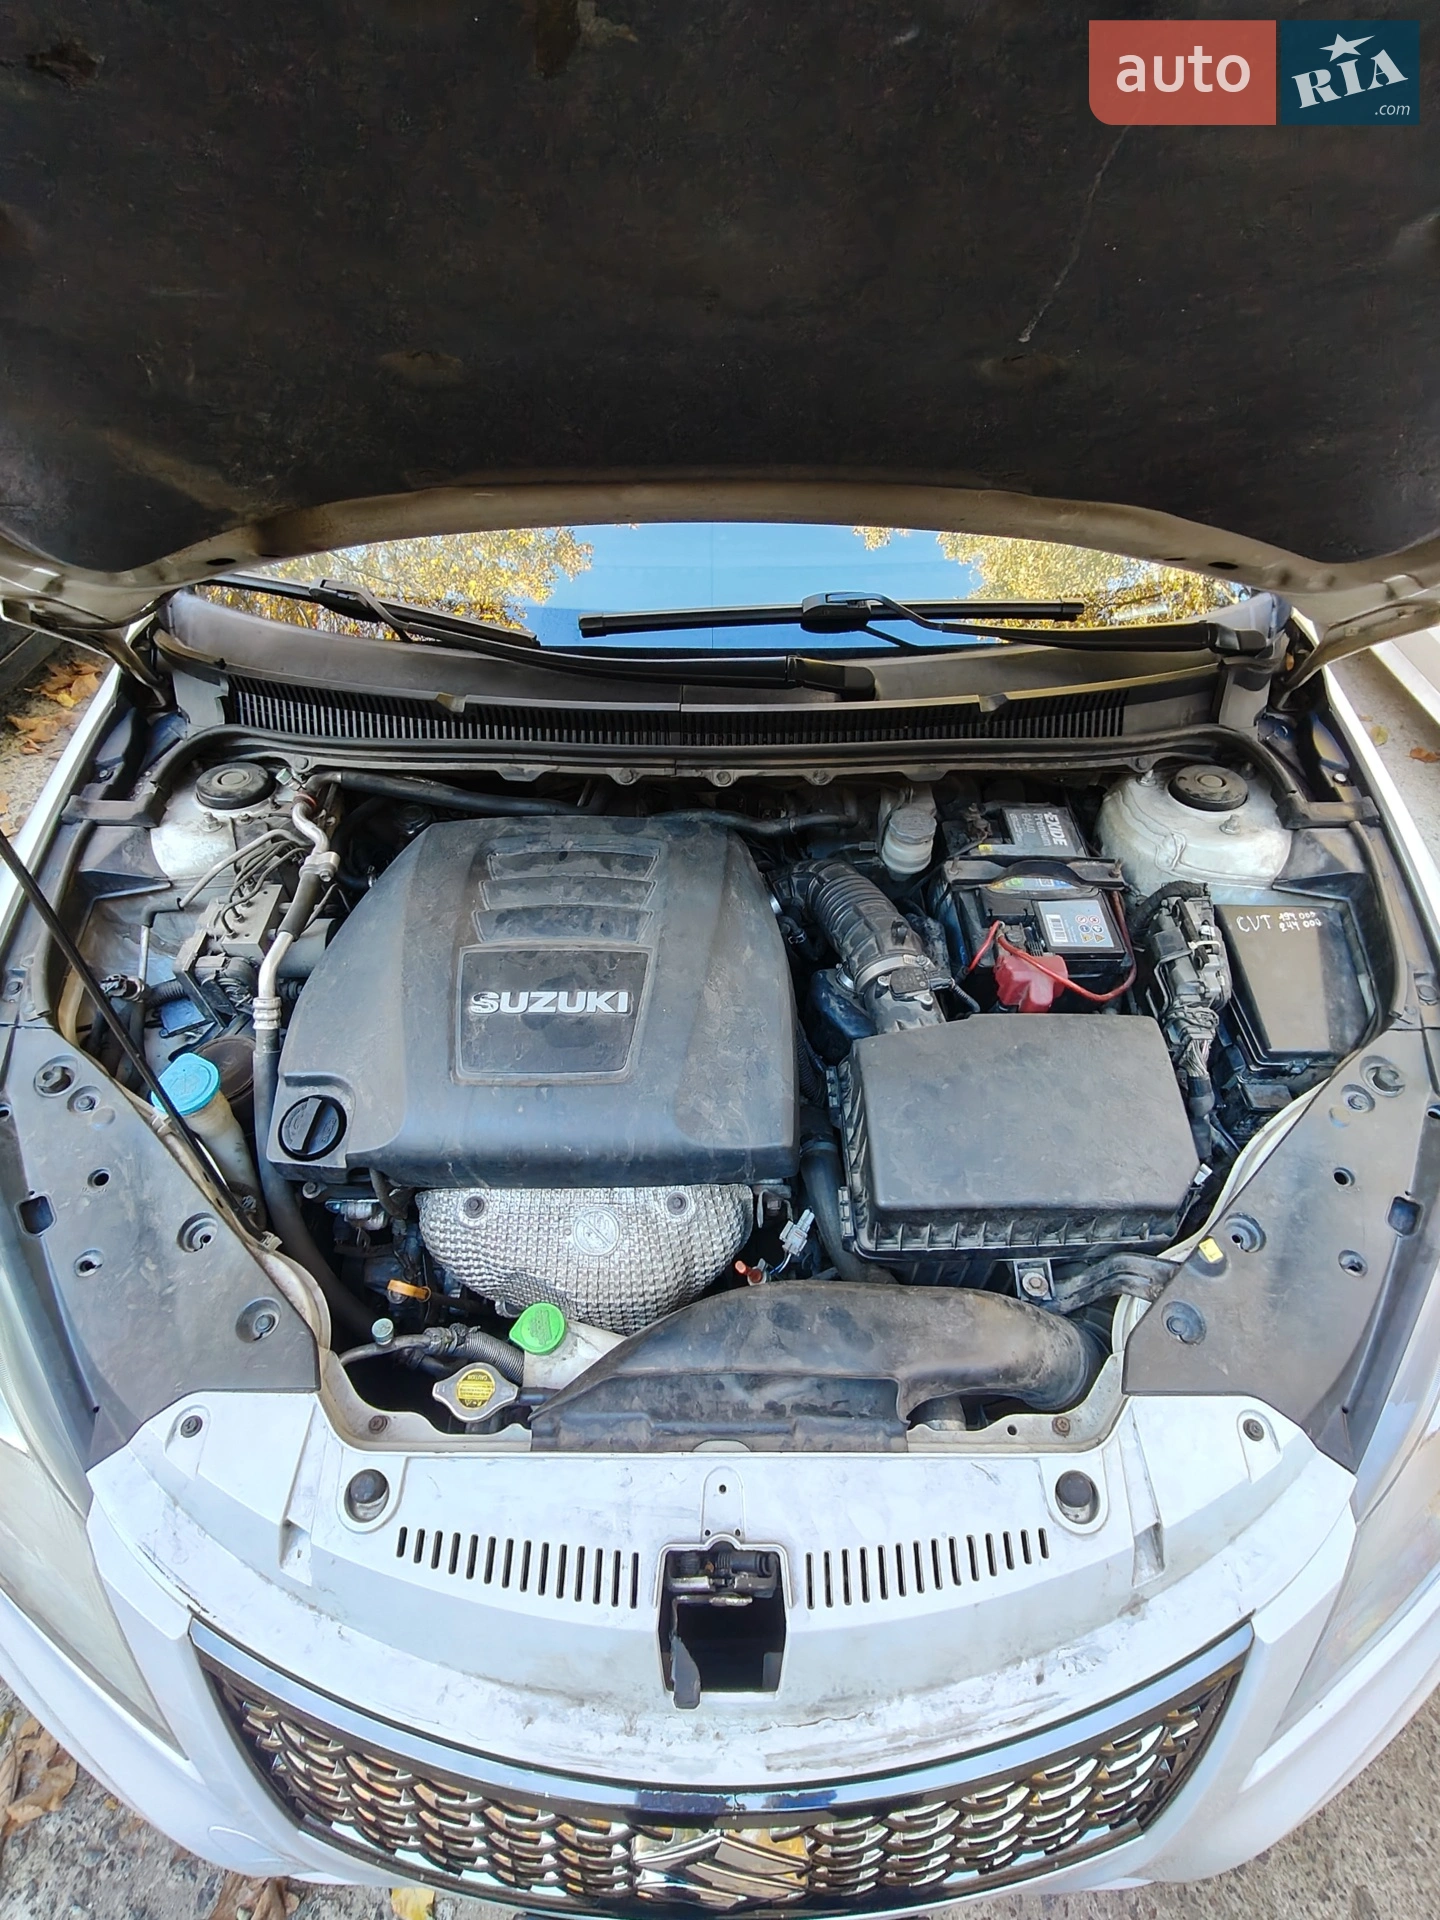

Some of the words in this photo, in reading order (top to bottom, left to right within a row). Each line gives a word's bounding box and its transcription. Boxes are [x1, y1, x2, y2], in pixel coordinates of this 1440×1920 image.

[1033, 813, 1052, 847] Premium
[1043, 811, 1068, 847] EXIDE
[1236, 914, 1271, 933] CVT
[1279, 920, 1300, 932] 244
[1302, 918, 1322, 928] 000
[470, 991, 629, 1014] SUZUKI
